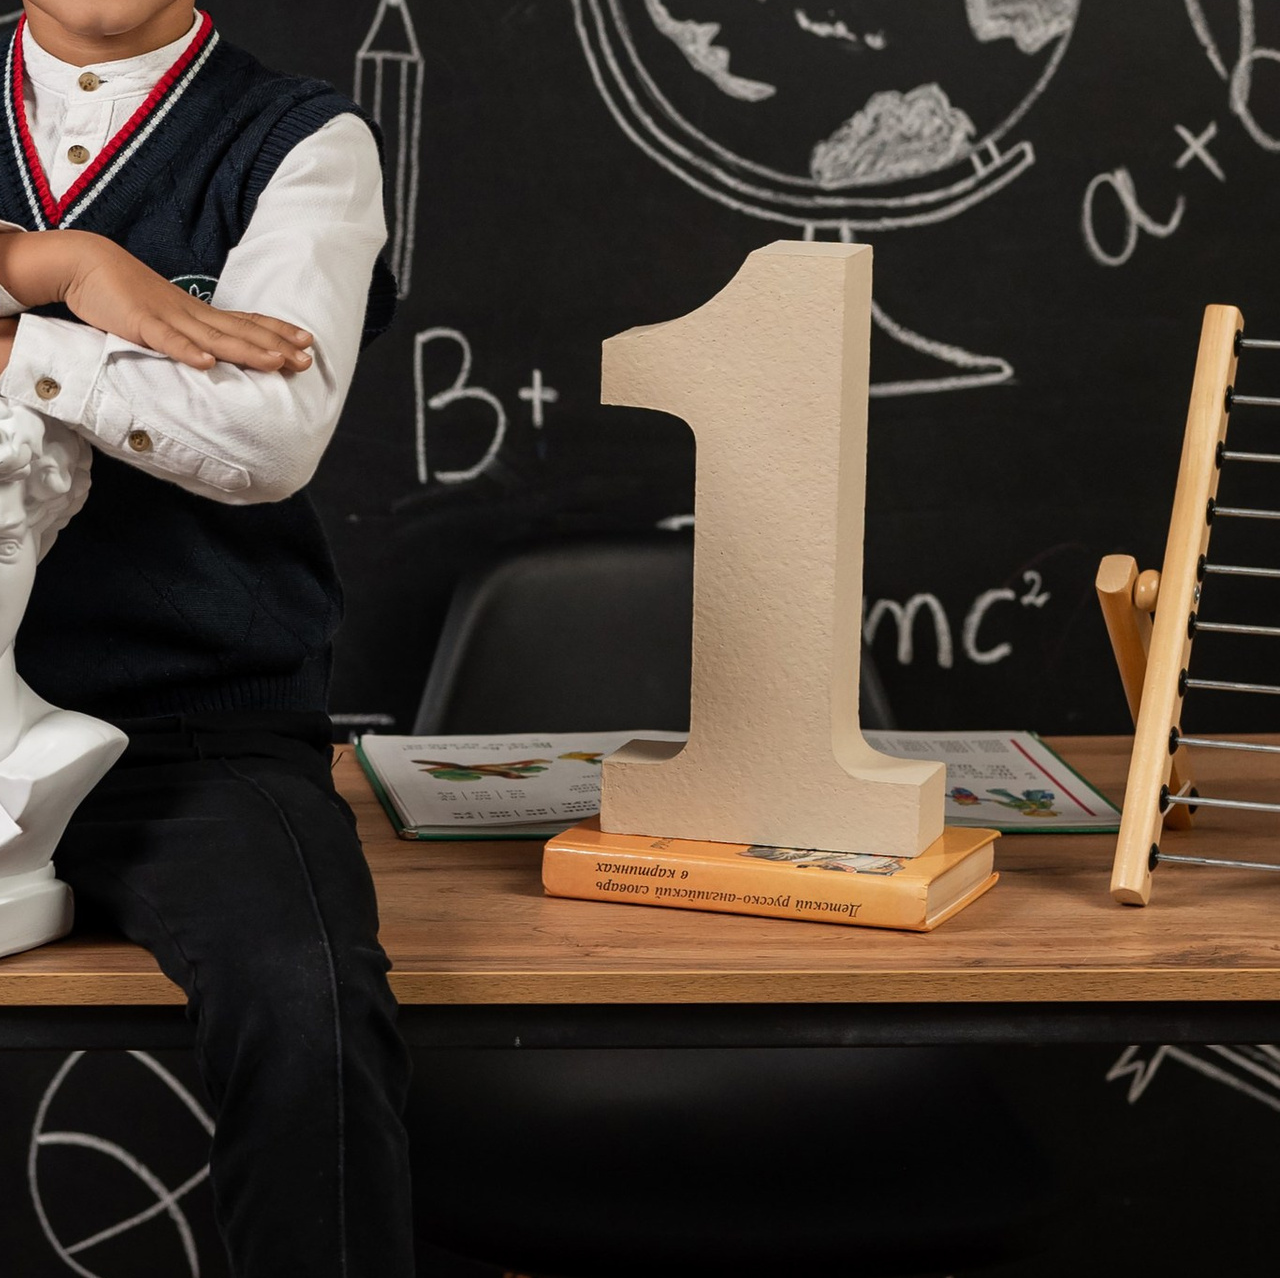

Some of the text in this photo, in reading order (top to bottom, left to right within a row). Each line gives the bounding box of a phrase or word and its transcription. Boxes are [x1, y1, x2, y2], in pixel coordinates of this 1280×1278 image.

[595, 862, 689, 881] в картинках
[595, 881, 862, 918] Детский русско-английский словарь
